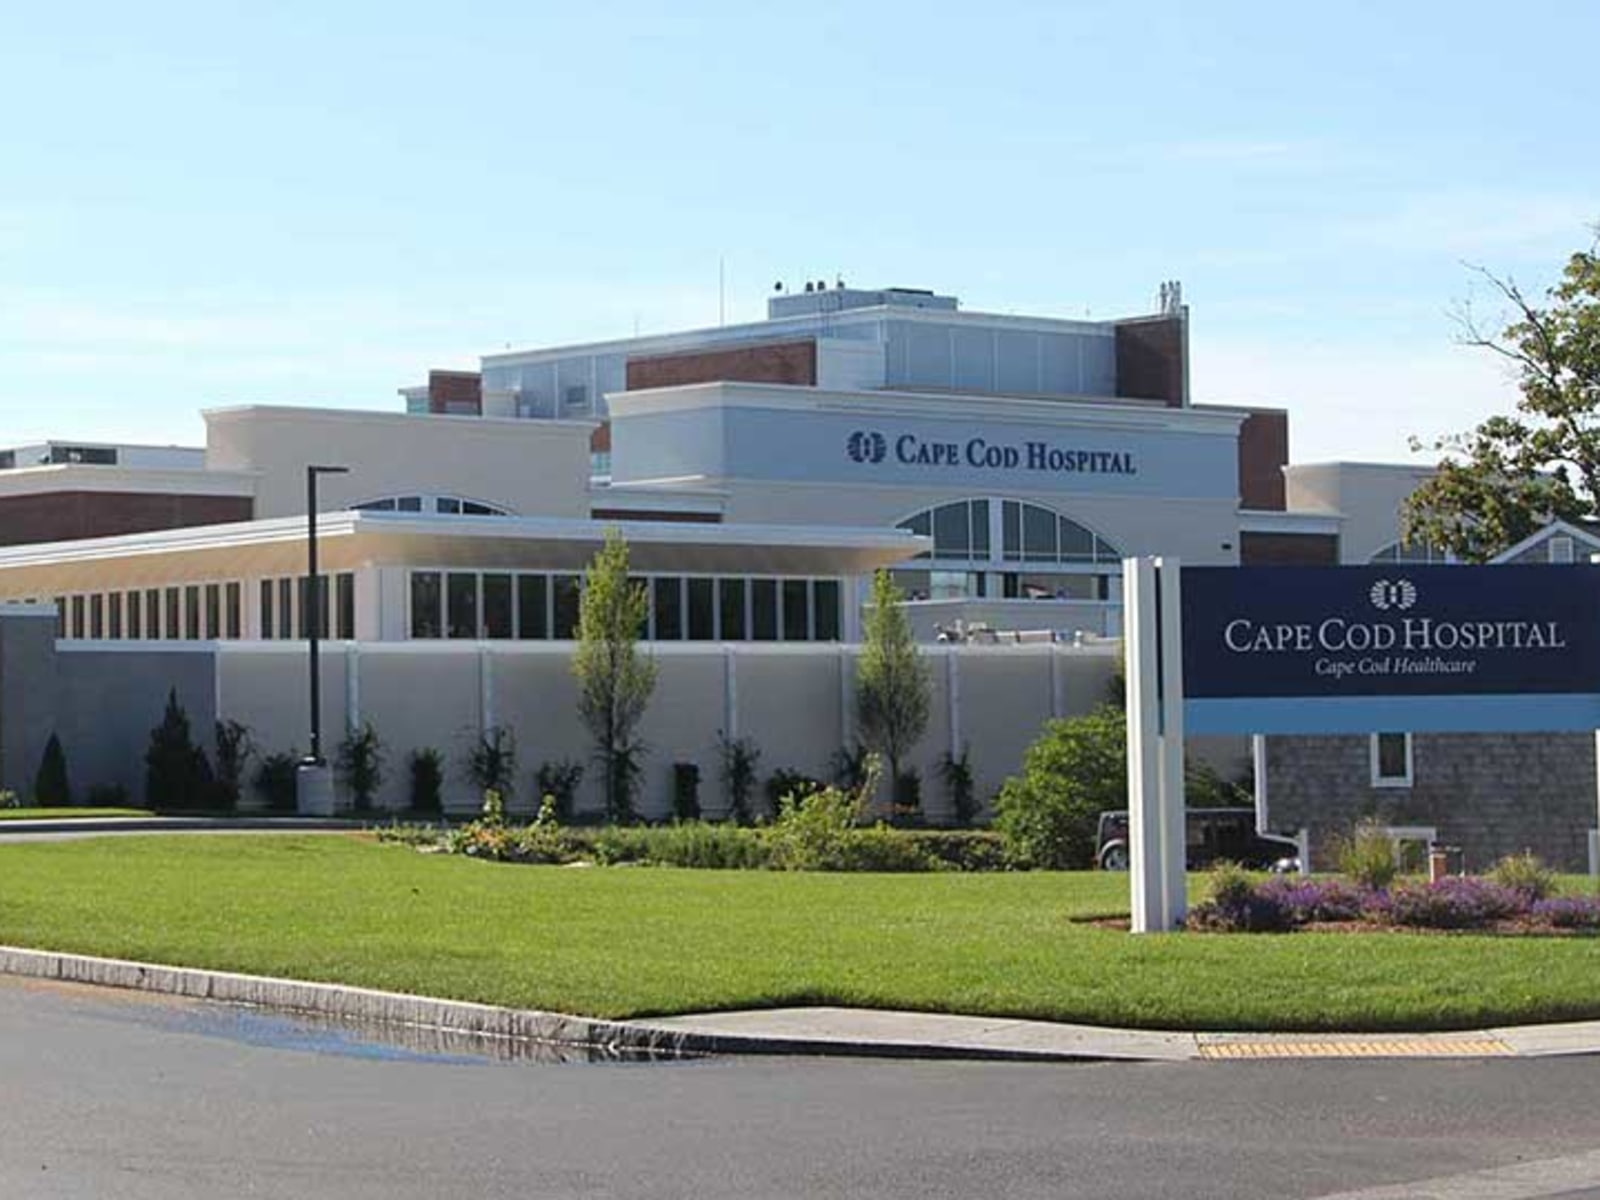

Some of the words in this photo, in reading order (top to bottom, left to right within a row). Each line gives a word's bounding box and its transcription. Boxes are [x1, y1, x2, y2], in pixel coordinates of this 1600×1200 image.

[895, 434, 959, 465] CAPE
[966, 438, 1019, 468] COD
[1024, 442, 1137, 475] HOSPITAL
[1224, 619, 1312, 651] CAPE
[1318, 618, 1396, 650] COD
[1401, 618, 1566, 649] HOSPITAL
[1314, 657, 1356, 679] Cape
[1358, 656, 1390, 674] Cod
[1392, 656, 1477, 674] Healthcare
